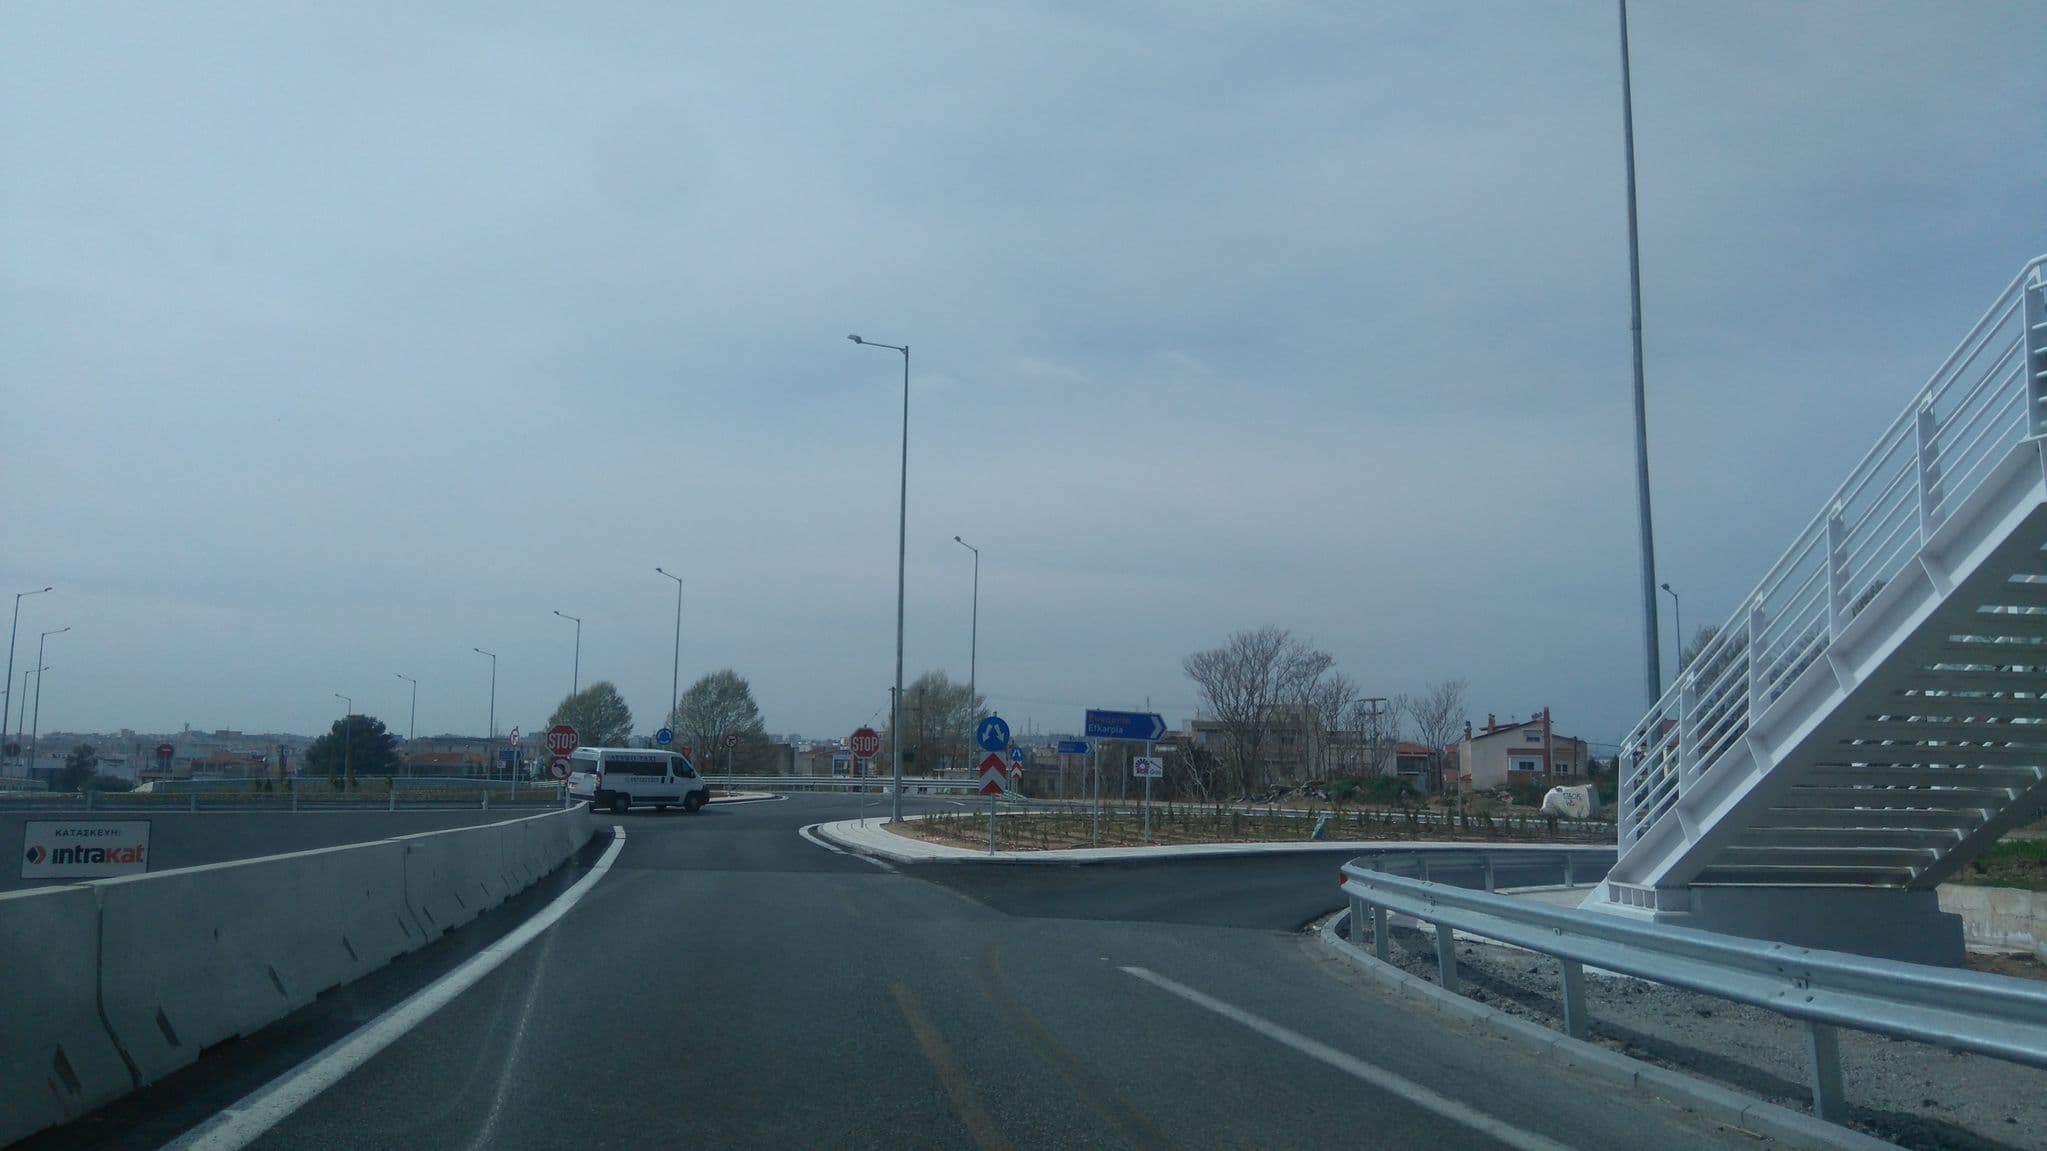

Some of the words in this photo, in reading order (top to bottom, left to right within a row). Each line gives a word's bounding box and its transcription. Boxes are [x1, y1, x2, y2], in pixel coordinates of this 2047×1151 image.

[548, 732, 577, 749] STOP
[852, 736, 878, 751] STOP
[52, 844, 145, 864] intrakat
